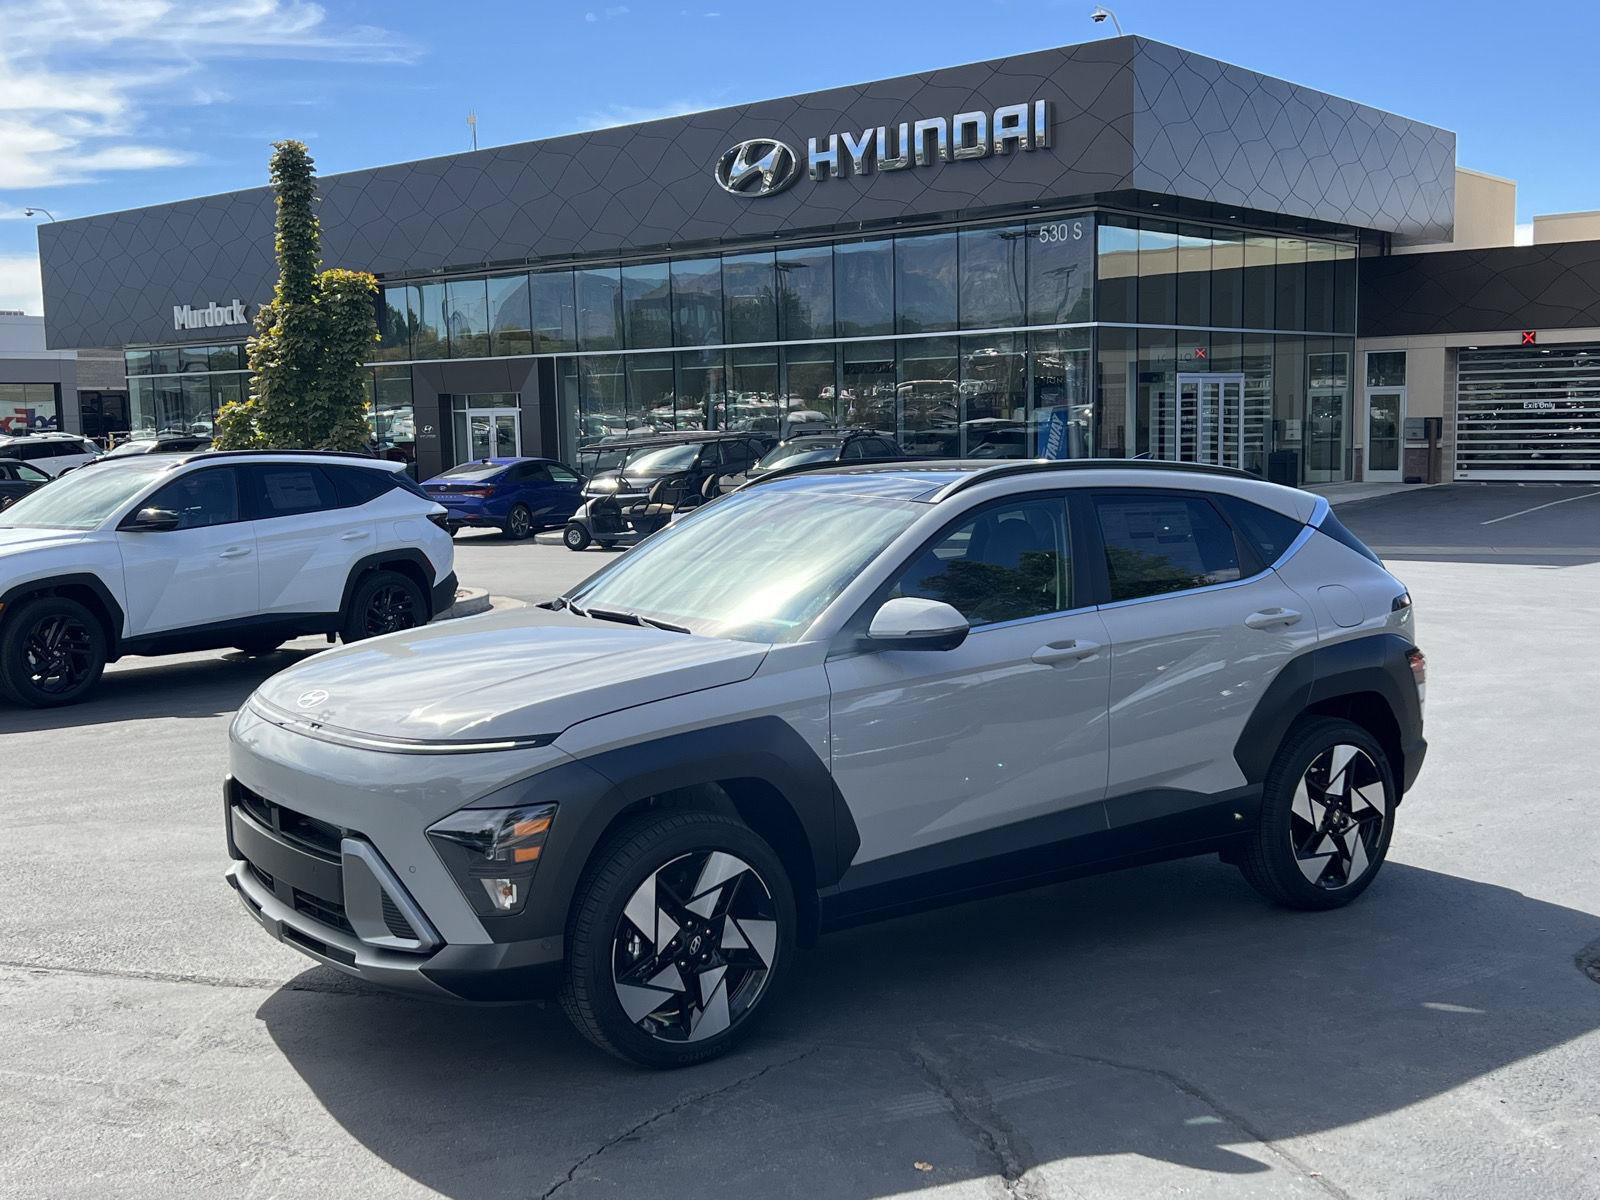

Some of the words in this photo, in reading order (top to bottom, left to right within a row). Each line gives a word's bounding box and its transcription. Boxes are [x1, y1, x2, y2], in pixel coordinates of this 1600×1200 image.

[807, 99, 1052, 181] HYUNDAI
[1039, 223, 1068, 243] 530
[1073, 222, 1082, 240] S
[173, 299, 248, 330] Murdock
[1523, 401, 1538, 409] Exit
[1539, 401, 1556, 410] Only
[1045, 412, 1064, 460] TAWAY
